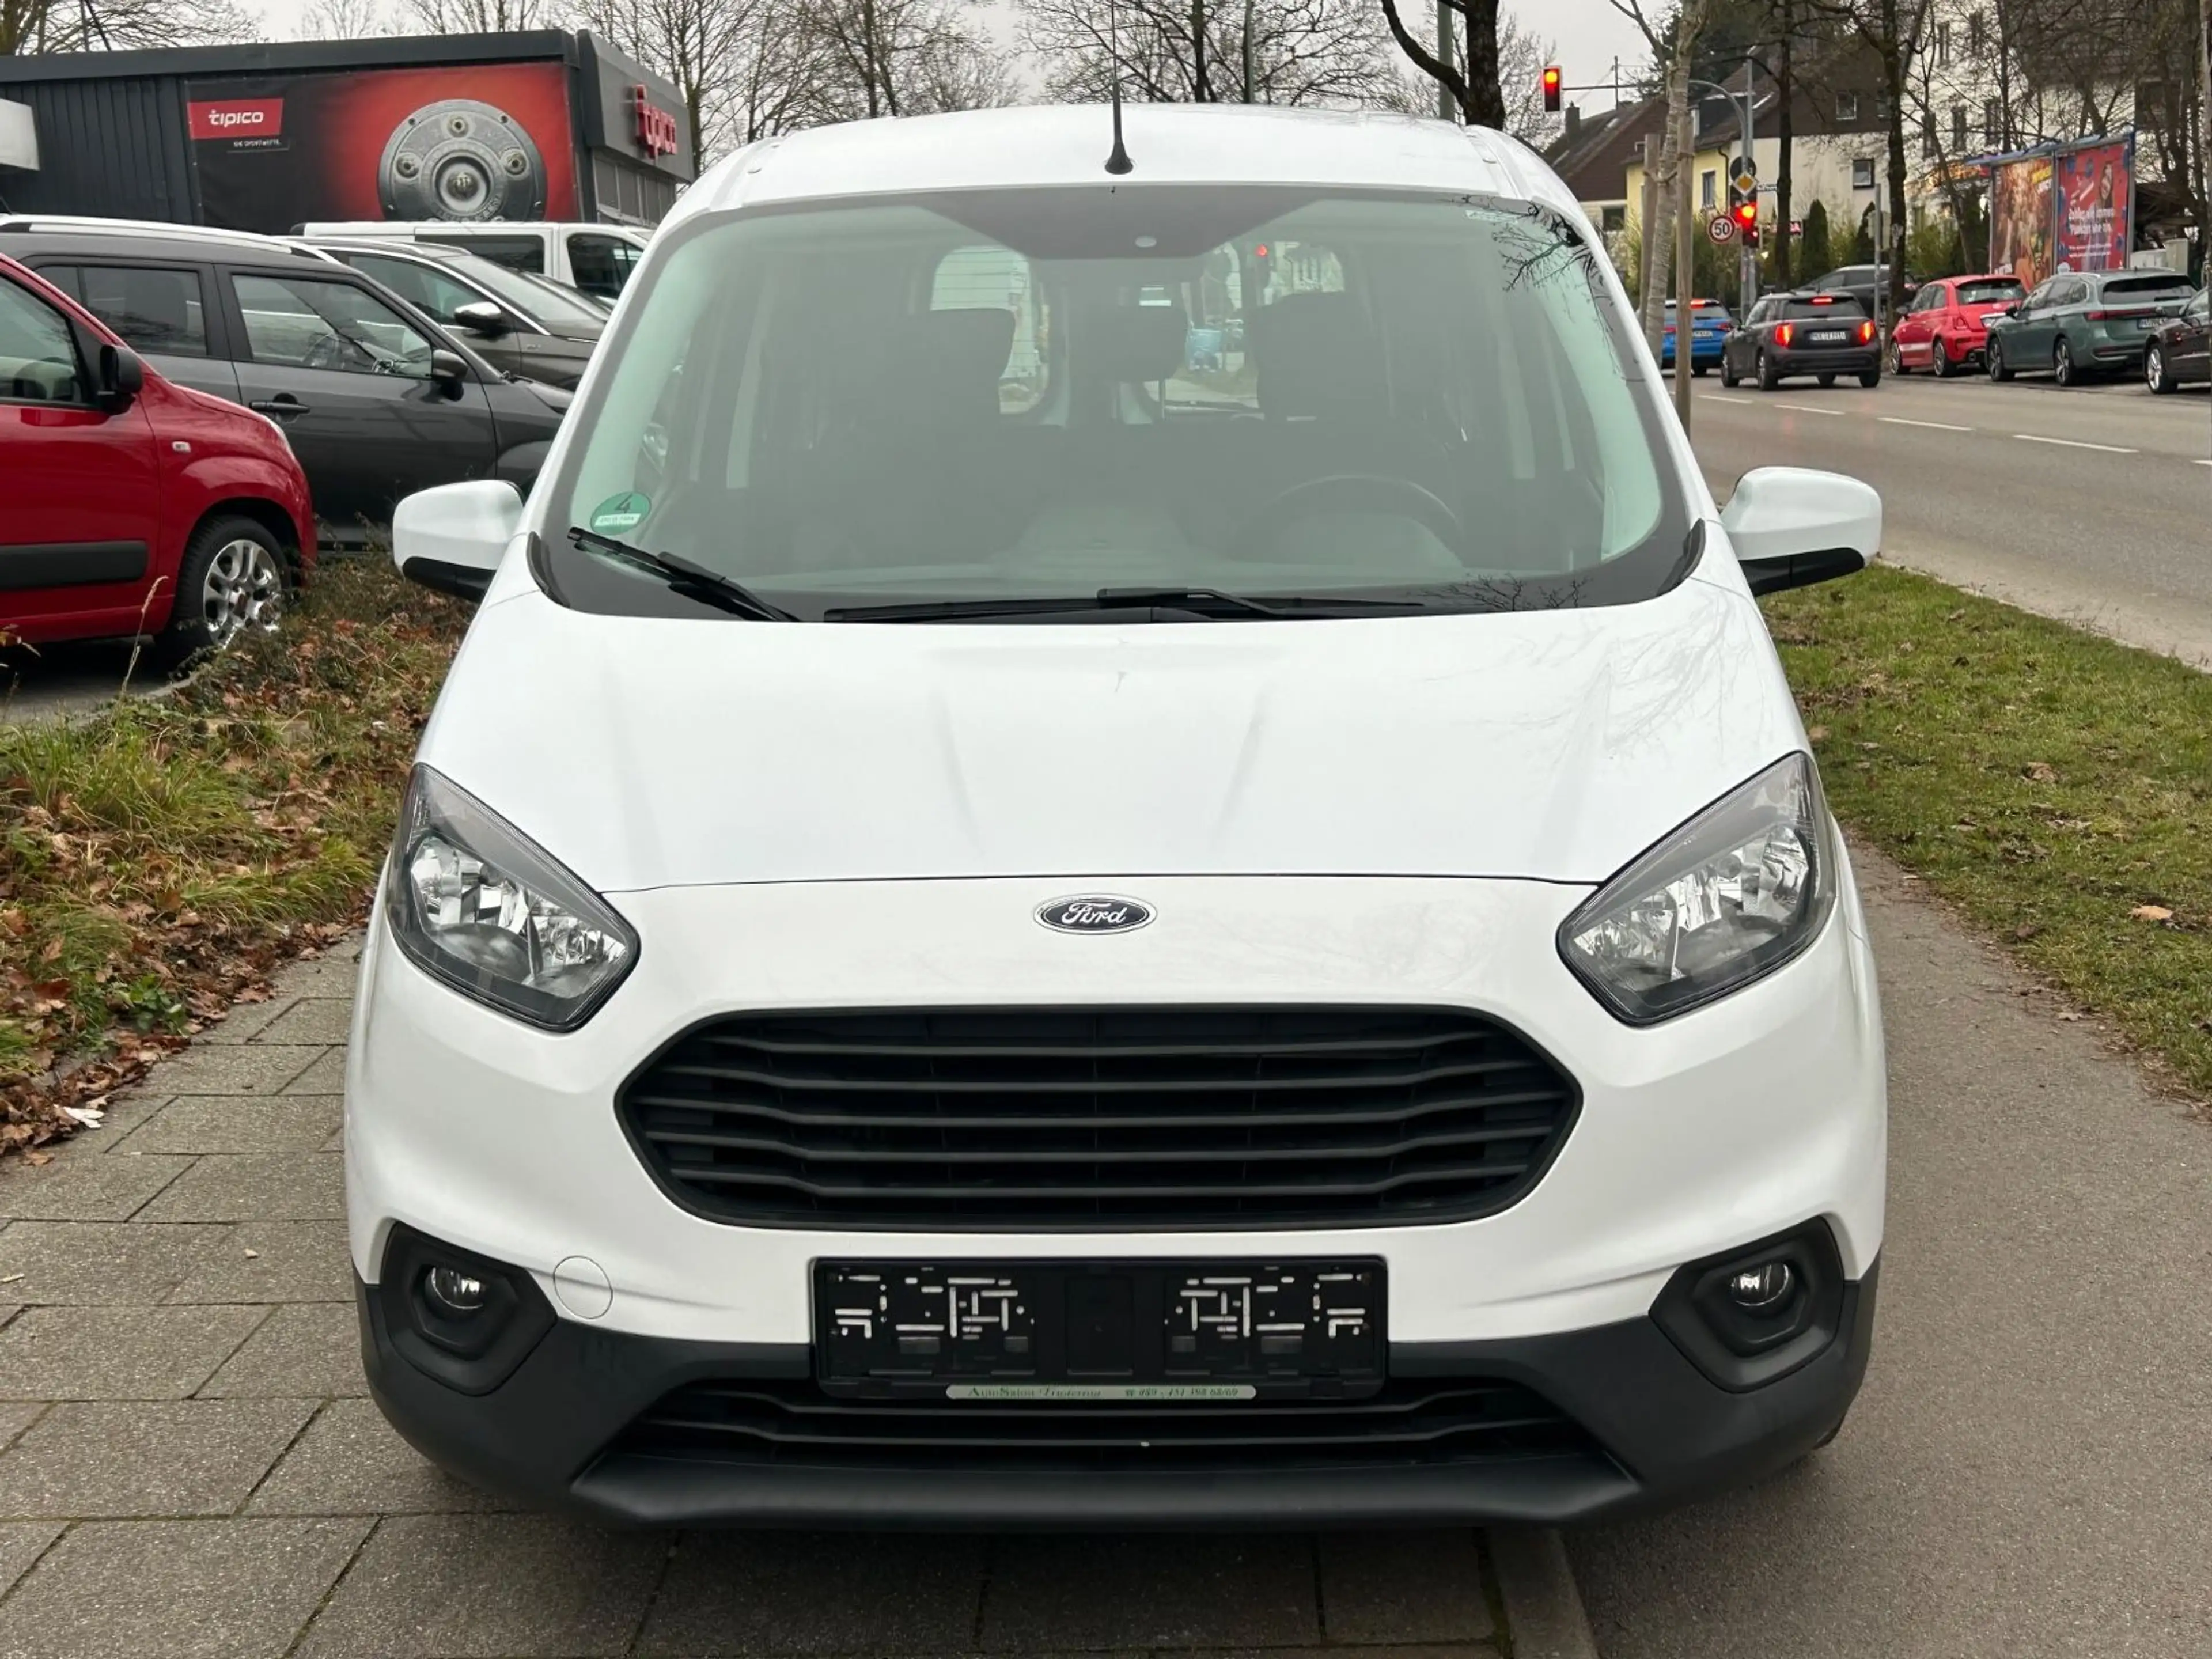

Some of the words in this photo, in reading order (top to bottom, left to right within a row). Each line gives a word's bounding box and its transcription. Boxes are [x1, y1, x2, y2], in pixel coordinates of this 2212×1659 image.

[209, 109, 264, 127] tipico
[1714, 222, 1730, 236] 50
[614, 493, 632, 514] 4
[1062, 902, 1127, 924] Ford
